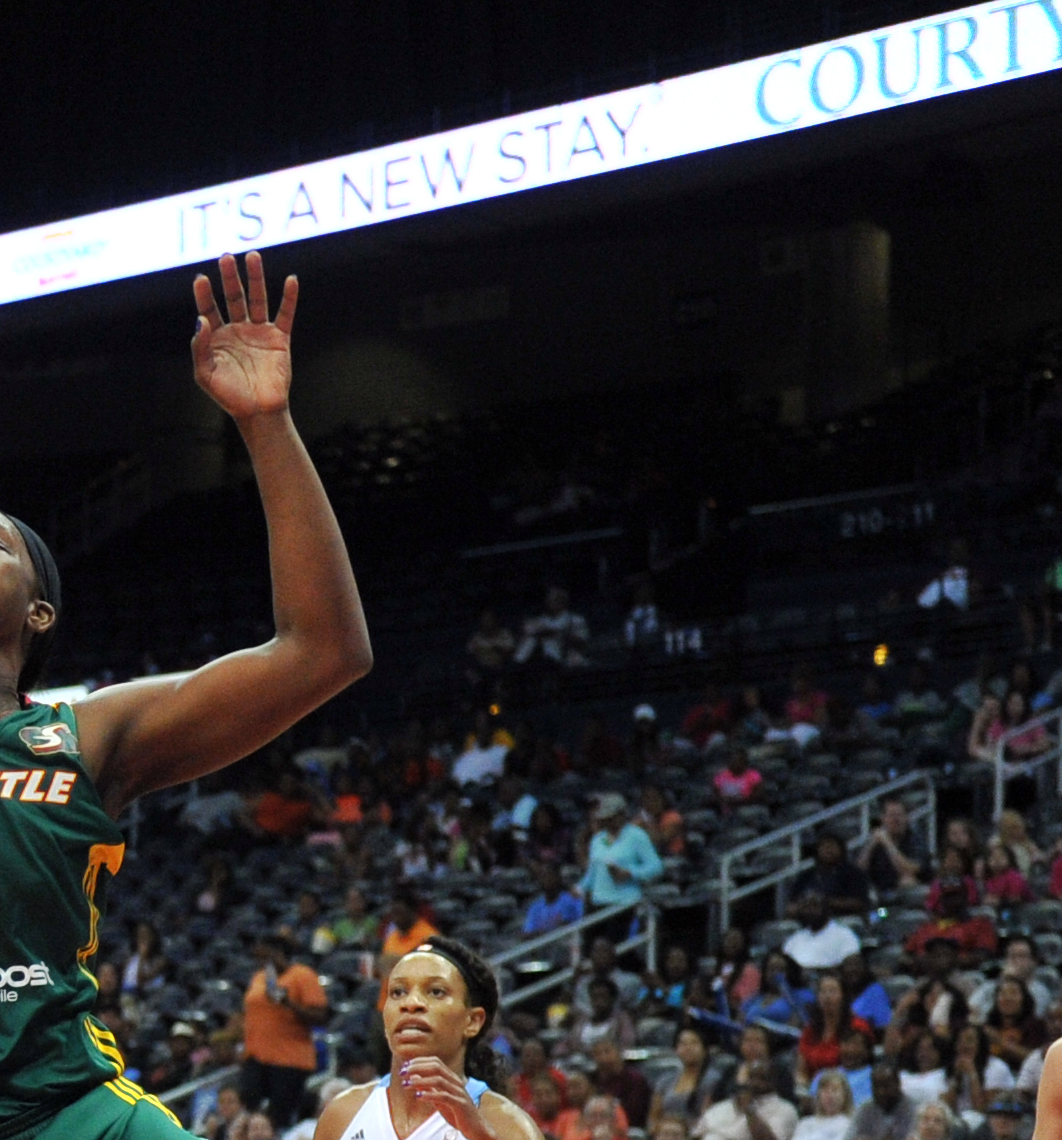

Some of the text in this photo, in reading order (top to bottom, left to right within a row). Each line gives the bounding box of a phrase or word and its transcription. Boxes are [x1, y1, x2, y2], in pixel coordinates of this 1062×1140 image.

[177, 191, 265, 259] IT'S
[285, 180, 319, 232] A
[340, 141, 476, 219] NEW
